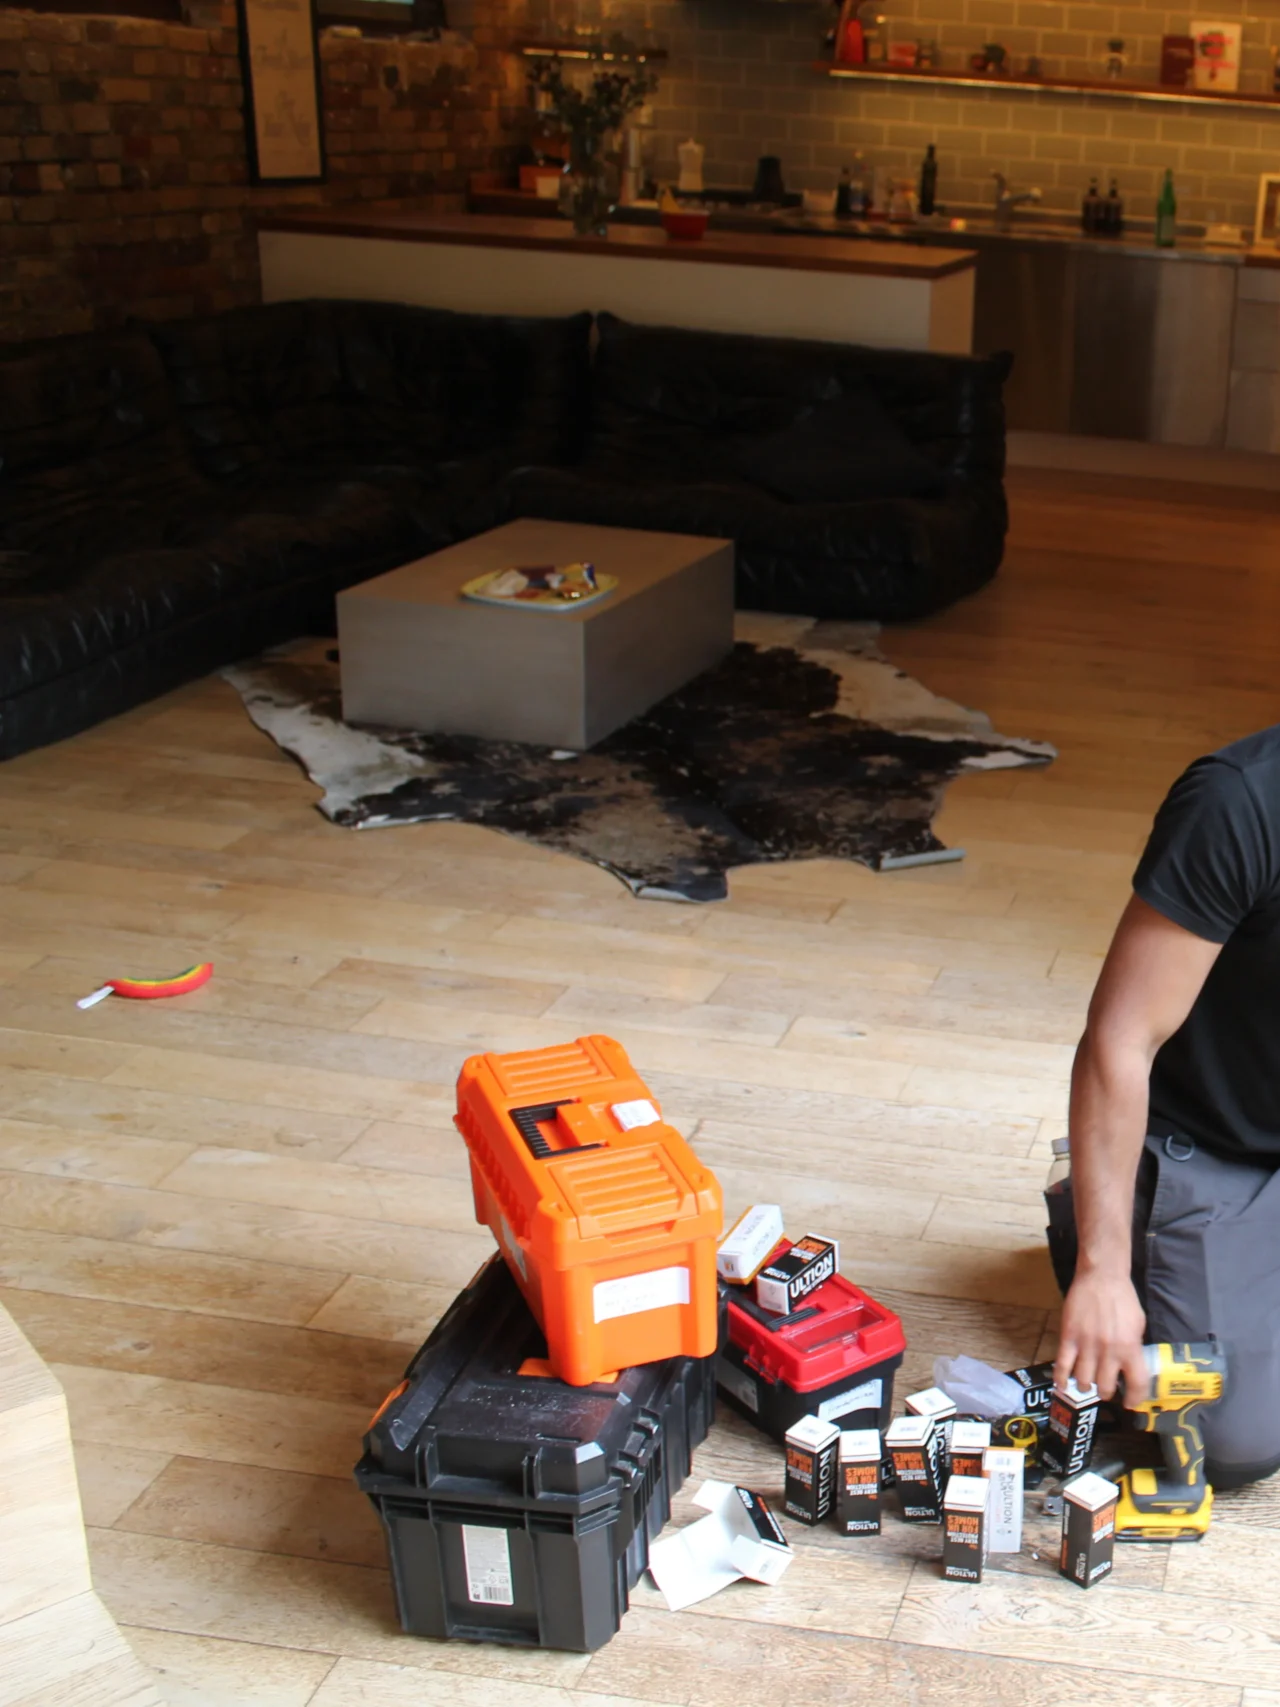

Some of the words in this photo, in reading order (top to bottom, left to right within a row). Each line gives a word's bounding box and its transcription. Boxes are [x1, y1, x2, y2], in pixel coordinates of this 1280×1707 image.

[790, 1252, 833, 1298] ULTION
[1067, 1410, 1091, 1475] ULTION
[817, 1448, 831, 1519] ULTION
[905, 1508, 935, 1517] ULTION
[1003, 1490, 1013, 1524] ULTION
[847, 1521, 879, 1531] ULTION
[947, 1515, 979, 1525] HOMES
[945, 1568, 977, 1579] ULTION
